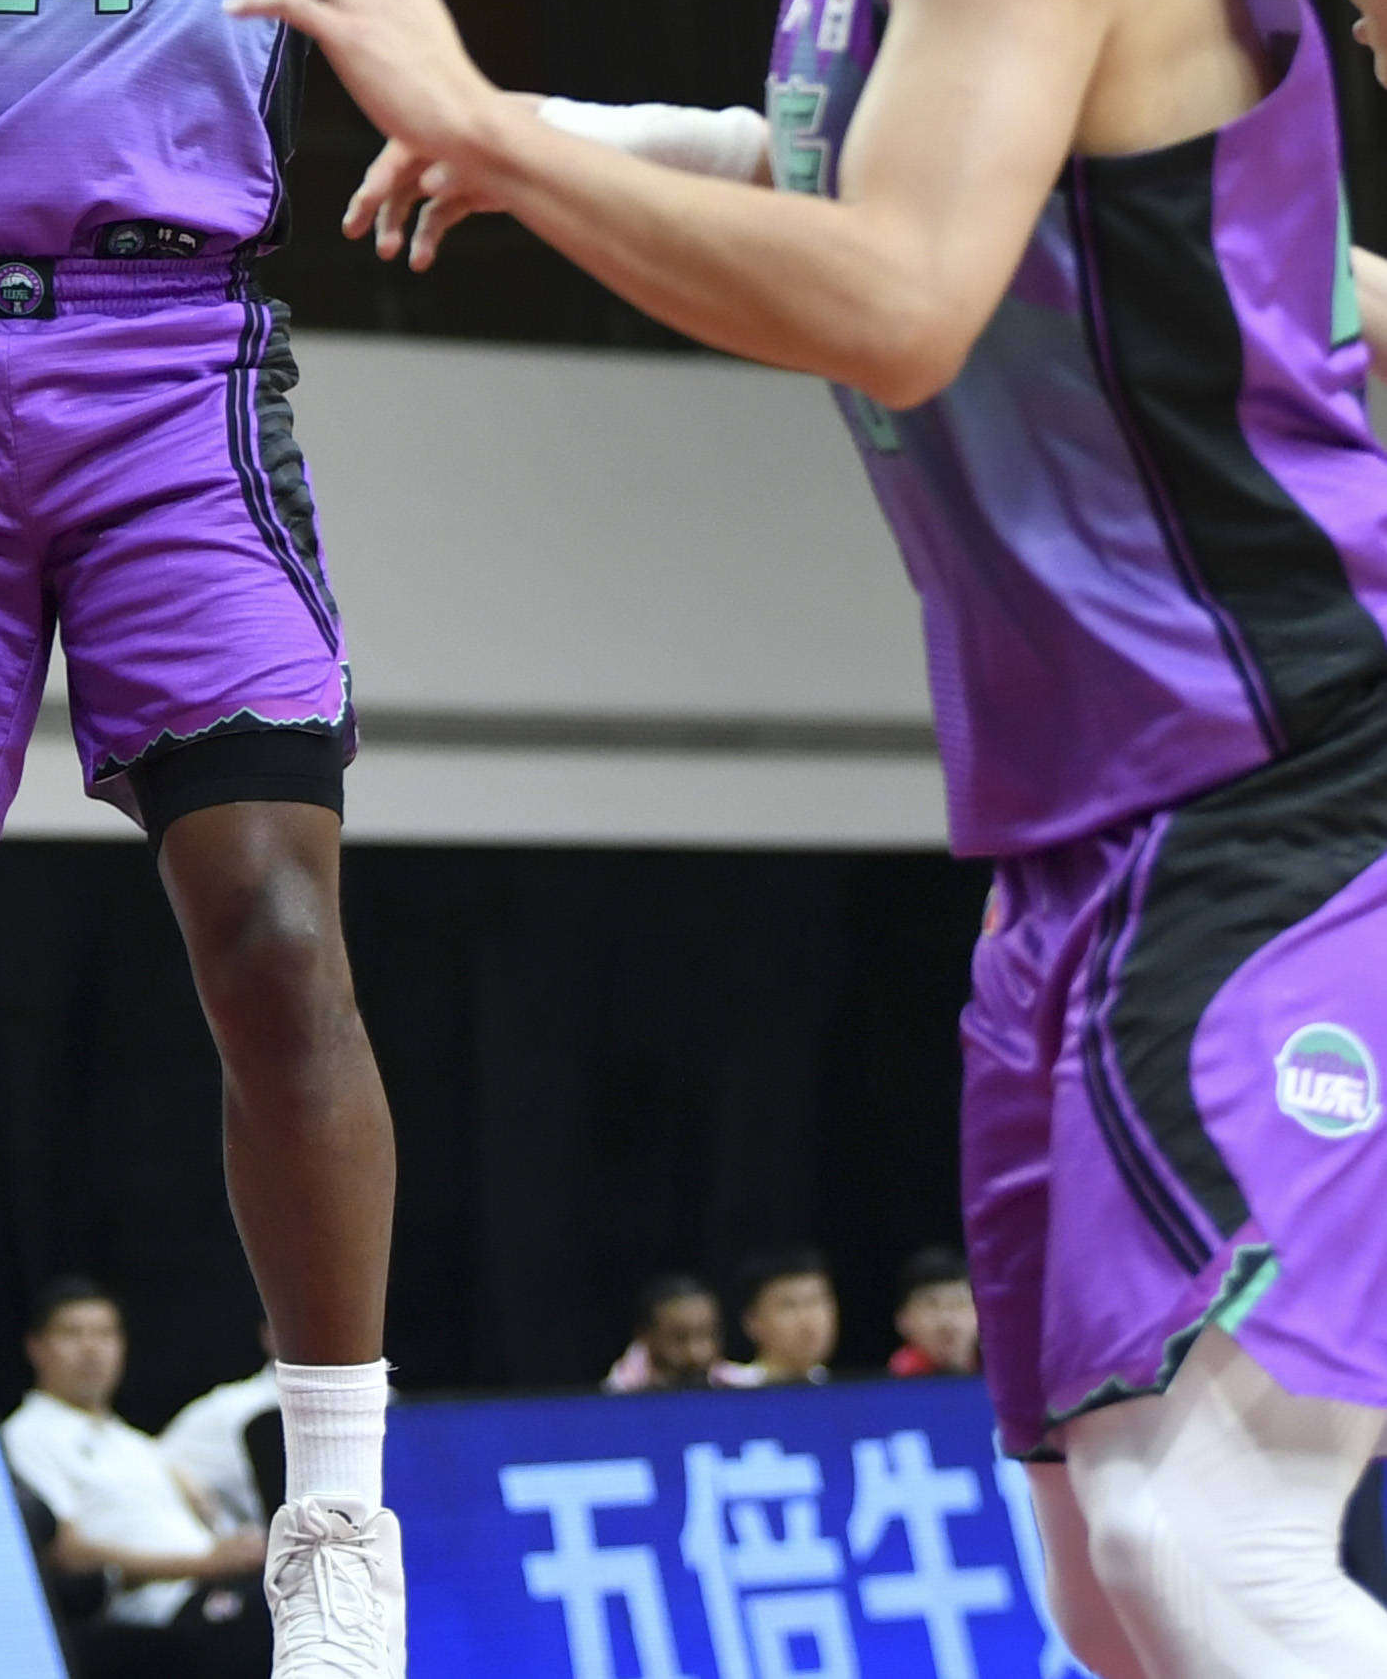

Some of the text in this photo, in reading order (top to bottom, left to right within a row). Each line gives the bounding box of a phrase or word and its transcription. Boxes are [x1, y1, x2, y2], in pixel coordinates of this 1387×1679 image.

[1282, 1066, 1367, 1120] 山东
[499, 1428, 1103, 1679] 五倍牛
